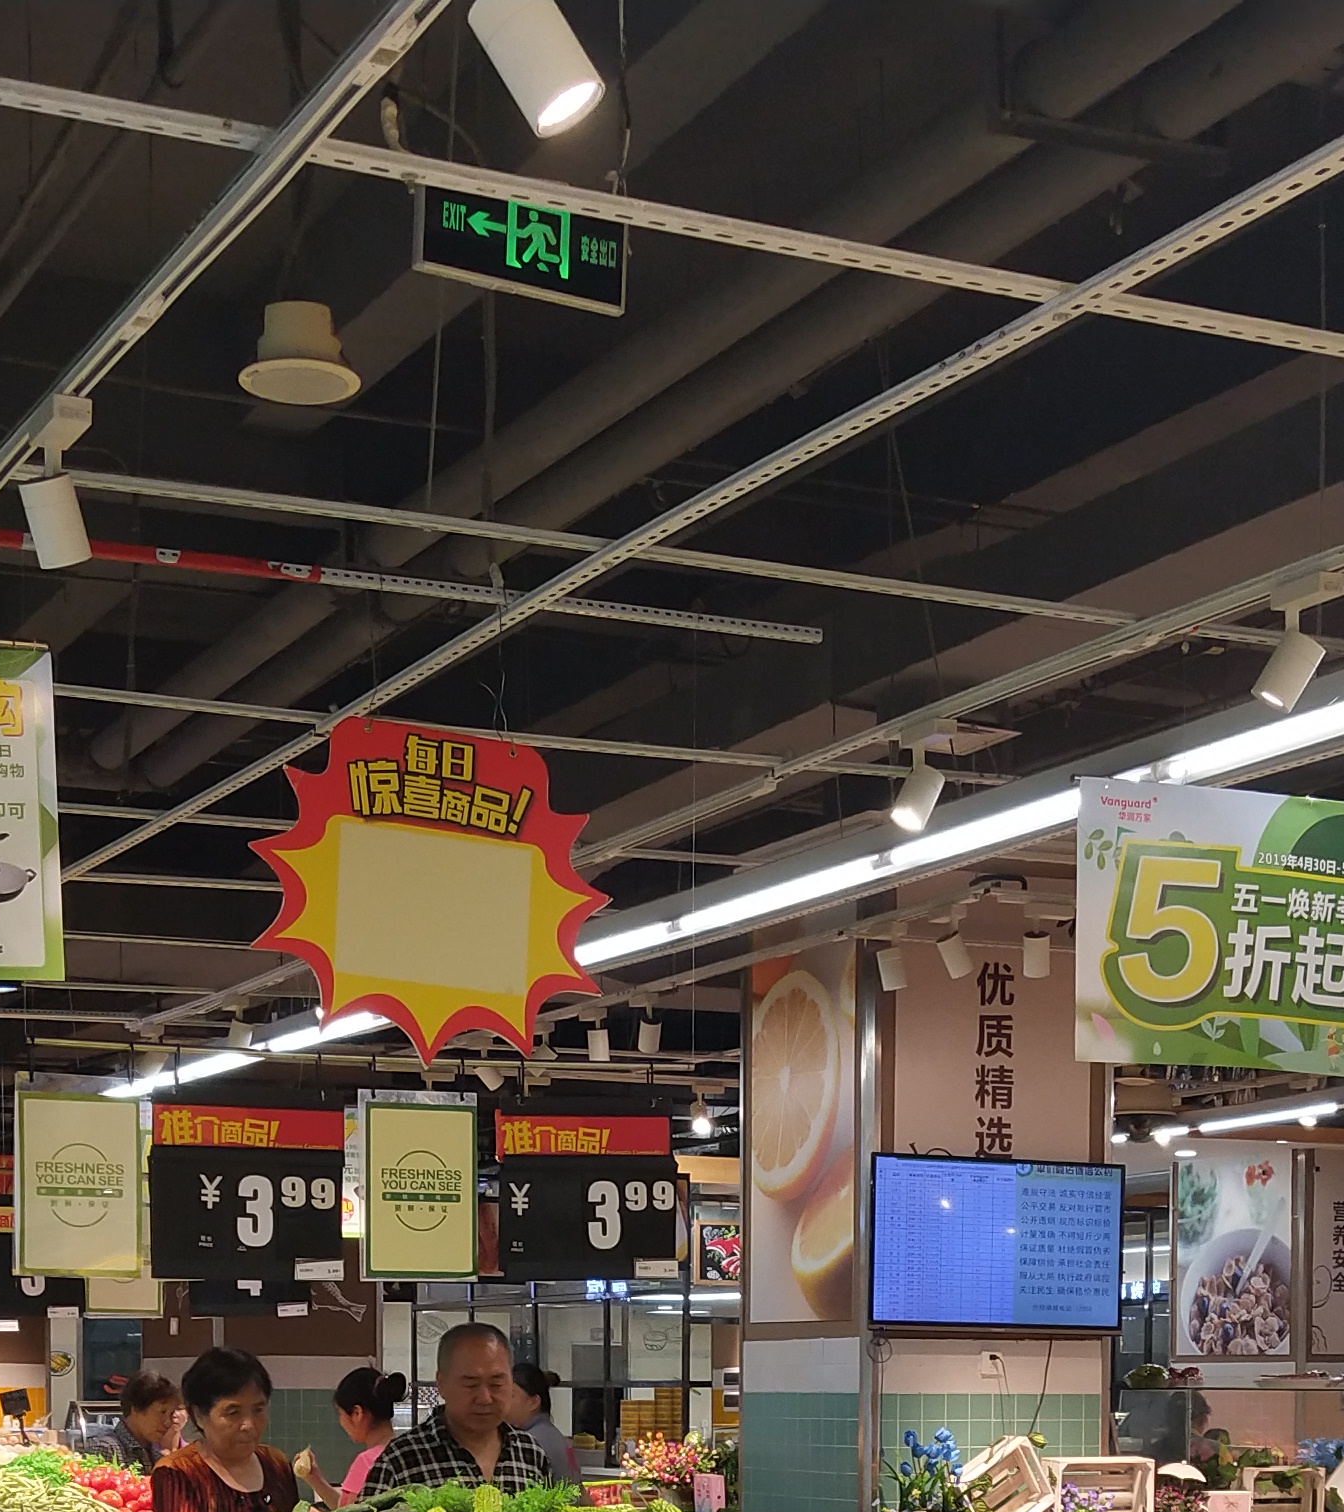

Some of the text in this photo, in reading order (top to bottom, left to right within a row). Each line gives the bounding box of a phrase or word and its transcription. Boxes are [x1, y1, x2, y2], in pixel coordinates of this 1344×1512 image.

[442, 200, 467, 232] EXIT
[580, 235, 617, 269] 安全出口
[405, 733, 474, 782] 每日
[349, 760, 531, 835] 惊喜商品!
[1101, 796, 1151, 810] Vanguard
[1118, 856, 1222, 1002] 5
[975, 961, 1015, 1159] 优质精选
[35, 1162, 124, 1175] FRESHNESS
[36, 1174, 124, 1187] YOU CAN SEE
[381, 1168, 462, 1180] FRESHNESS
[382, 1180, 462, 1191] YOU CAN SEE
